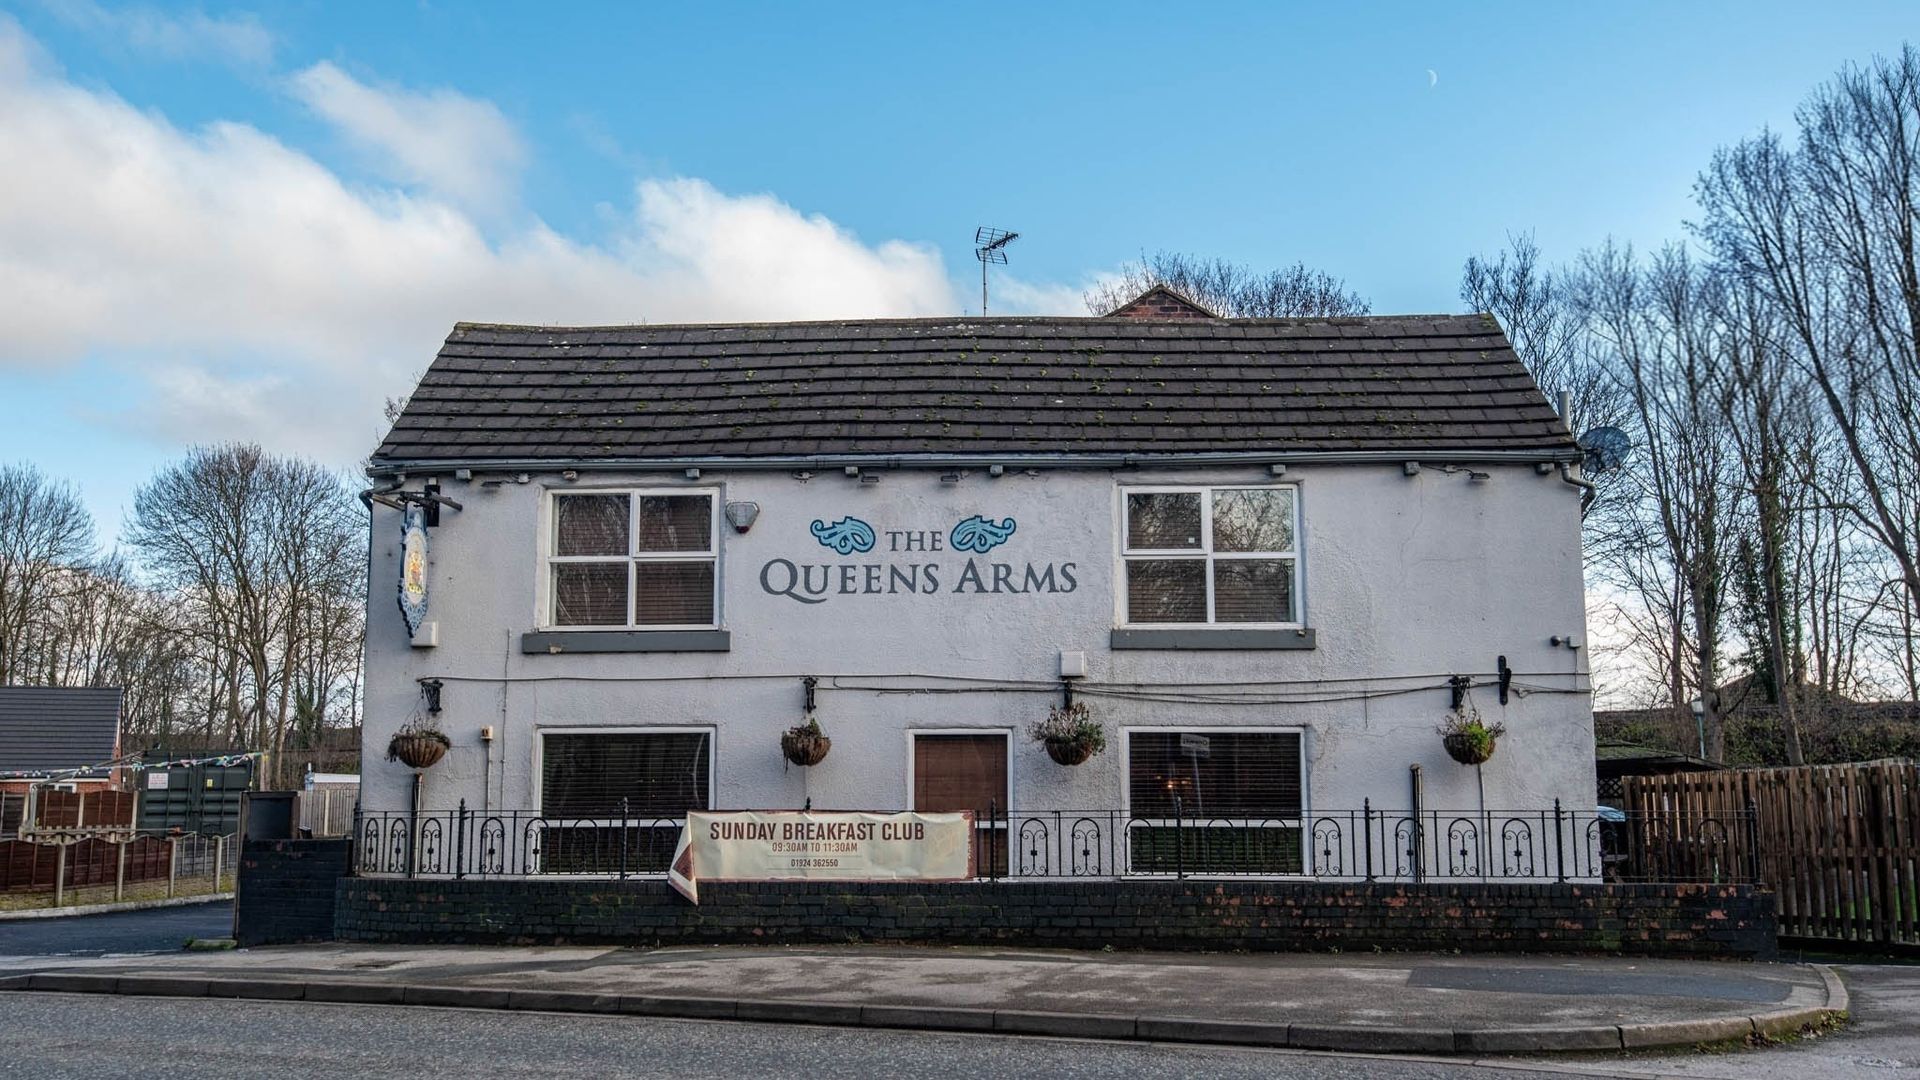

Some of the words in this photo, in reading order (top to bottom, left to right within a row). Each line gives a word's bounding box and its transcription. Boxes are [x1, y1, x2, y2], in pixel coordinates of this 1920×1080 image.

[886, 530, 943, 552] THE
[759, 558, 940, 605] QUEENS
[951, 557, 1077, 594] ARMS
[710, 822, 777, 841] SUNDAY
[783, 822, 876, 841] BREAKFAST
[882, 822, 925, 841] CLUB
[771, 842, 808, 853] 09:30AM
[811, 842, 821, 853] TO
[824, 842, 858, 853] 11:30AM
[790, 858, 811, 868] 01924
[812, 858, 839, 868] 362550
